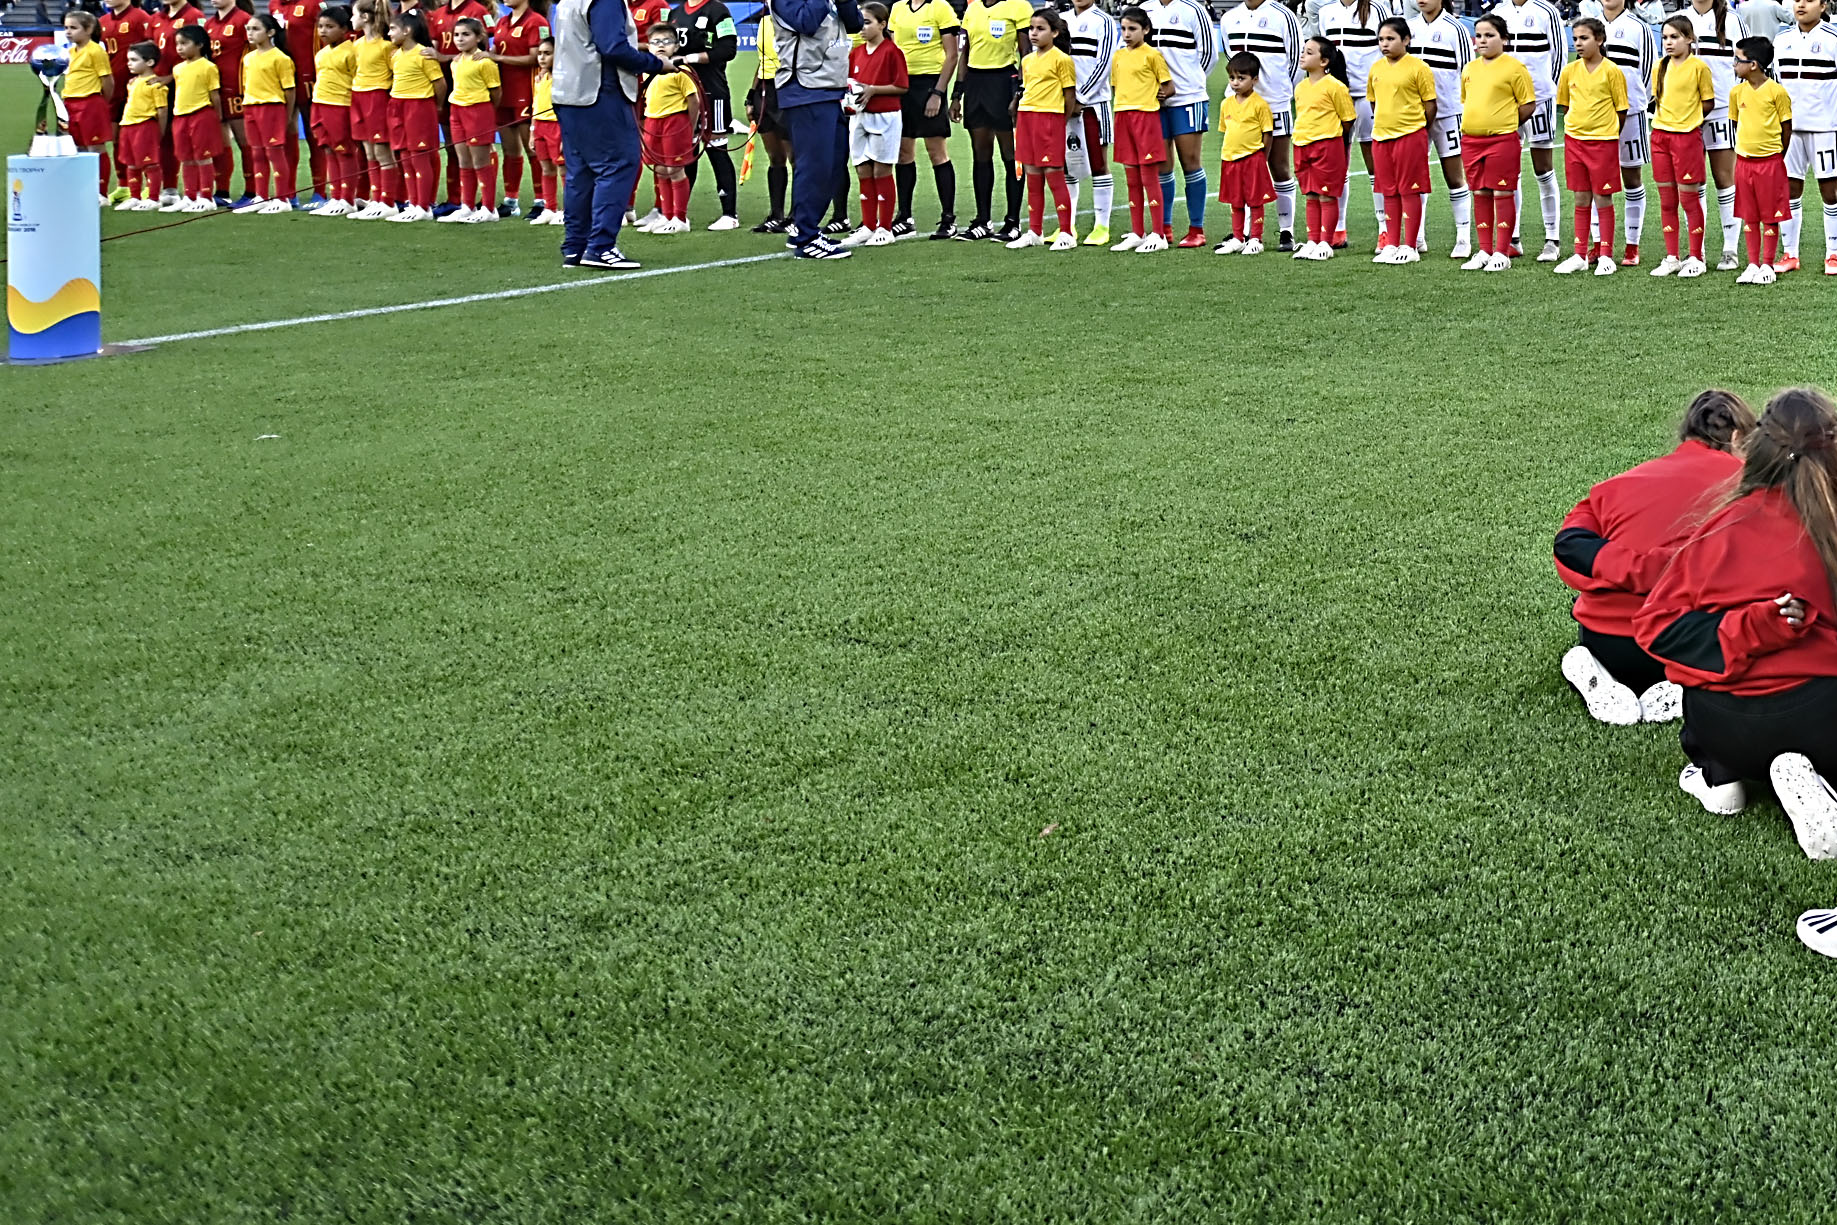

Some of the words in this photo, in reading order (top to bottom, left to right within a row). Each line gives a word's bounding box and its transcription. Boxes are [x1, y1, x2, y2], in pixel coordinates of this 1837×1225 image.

[159, 32, 166, 49] 6
[442, 31, 452, 49] 19
[227, 96, 244, 115] 18
[1531, 113, 1548, 136] 10
[1708, 121, 1728, 143] 14
[1446, 130, 1459, 151] 5
[1625, 139, 1641, 161] 11
[1817, 148, 1836, 172] 17
